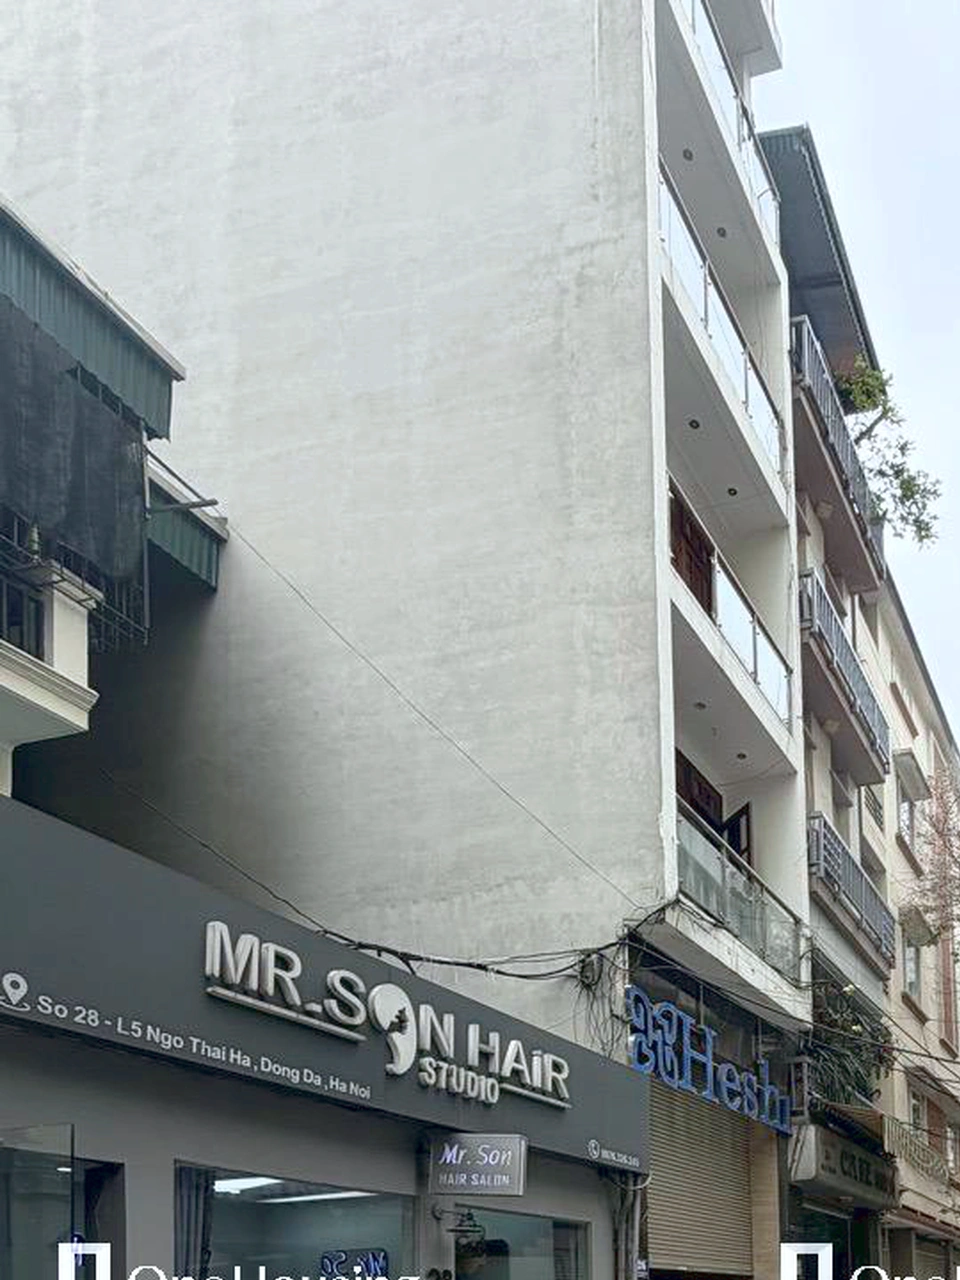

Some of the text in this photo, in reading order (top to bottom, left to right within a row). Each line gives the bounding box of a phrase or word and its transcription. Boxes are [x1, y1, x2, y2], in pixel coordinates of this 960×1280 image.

[37, 995, 68, 1019] So
[73, 1005, 100, 1028] 28
[116, 1016, 142, 1038] L5
[146, 1025, 185, 1050] Ngo
[189, 1036, 227, 1062] Thai
[260, 1056, 300, 1084] Dong
[349, 1080, 371, 1100] Noi
[418, 1056, 500, 1104] STUDIO
[476, 1144, 512, 1167] Son
[438, 1172, 467, 1186] HAIR
